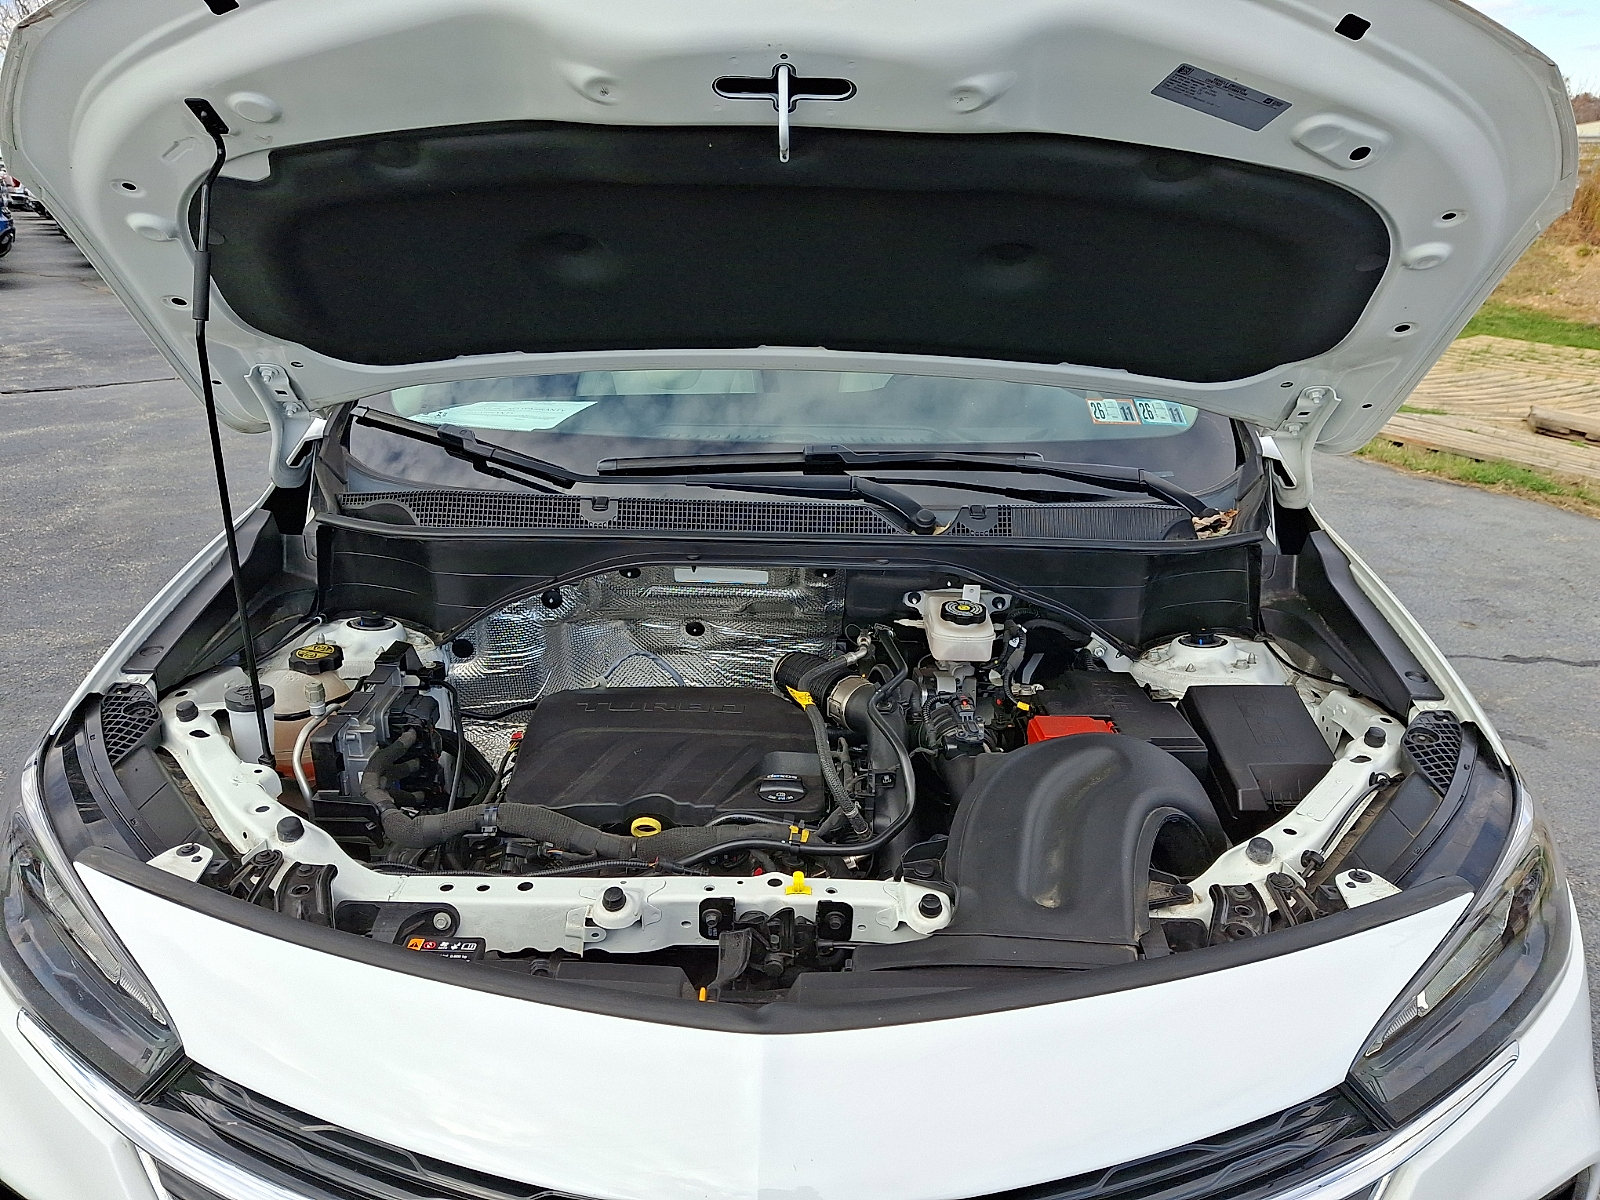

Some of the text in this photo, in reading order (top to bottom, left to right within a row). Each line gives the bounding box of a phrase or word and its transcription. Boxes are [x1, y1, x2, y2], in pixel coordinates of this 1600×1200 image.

[1090, 402, 1135, 421] 26 11
[1139, 402, 1183, 423] 26 11
[576, 702, 747, 714] TURBO
